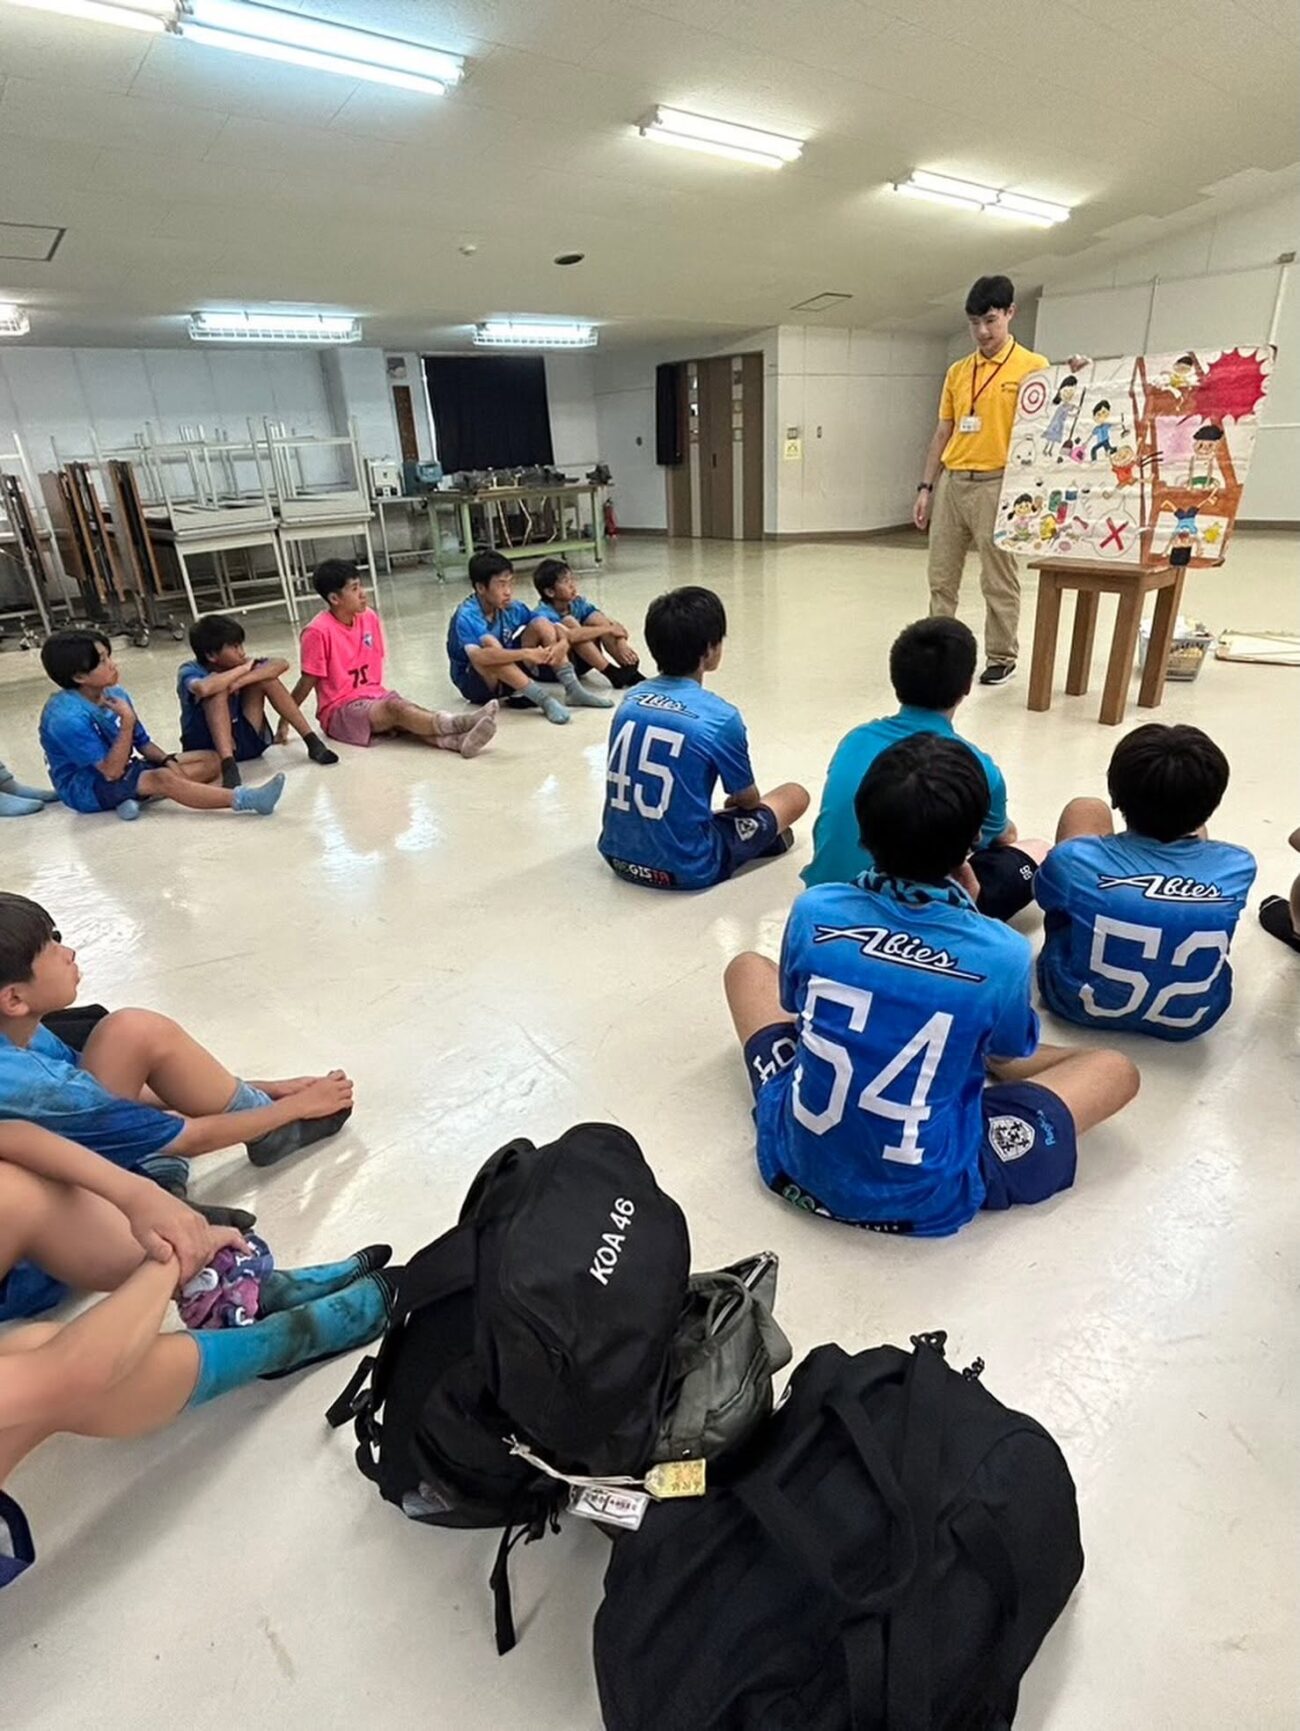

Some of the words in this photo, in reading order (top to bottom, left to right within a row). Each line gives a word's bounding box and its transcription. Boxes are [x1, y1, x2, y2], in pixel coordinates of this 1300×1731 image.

[606, 720, 685, 820] 45
[1098, 873, 1237, 904] Abies
[813, 924, 987, 984] Abies
[1078, 913, 1230, 1029] 52
[791, 974, 955, 1166] 54
[589, 1232, 626, 1286] KOA
[609, 1197, 635, 1231] 46
